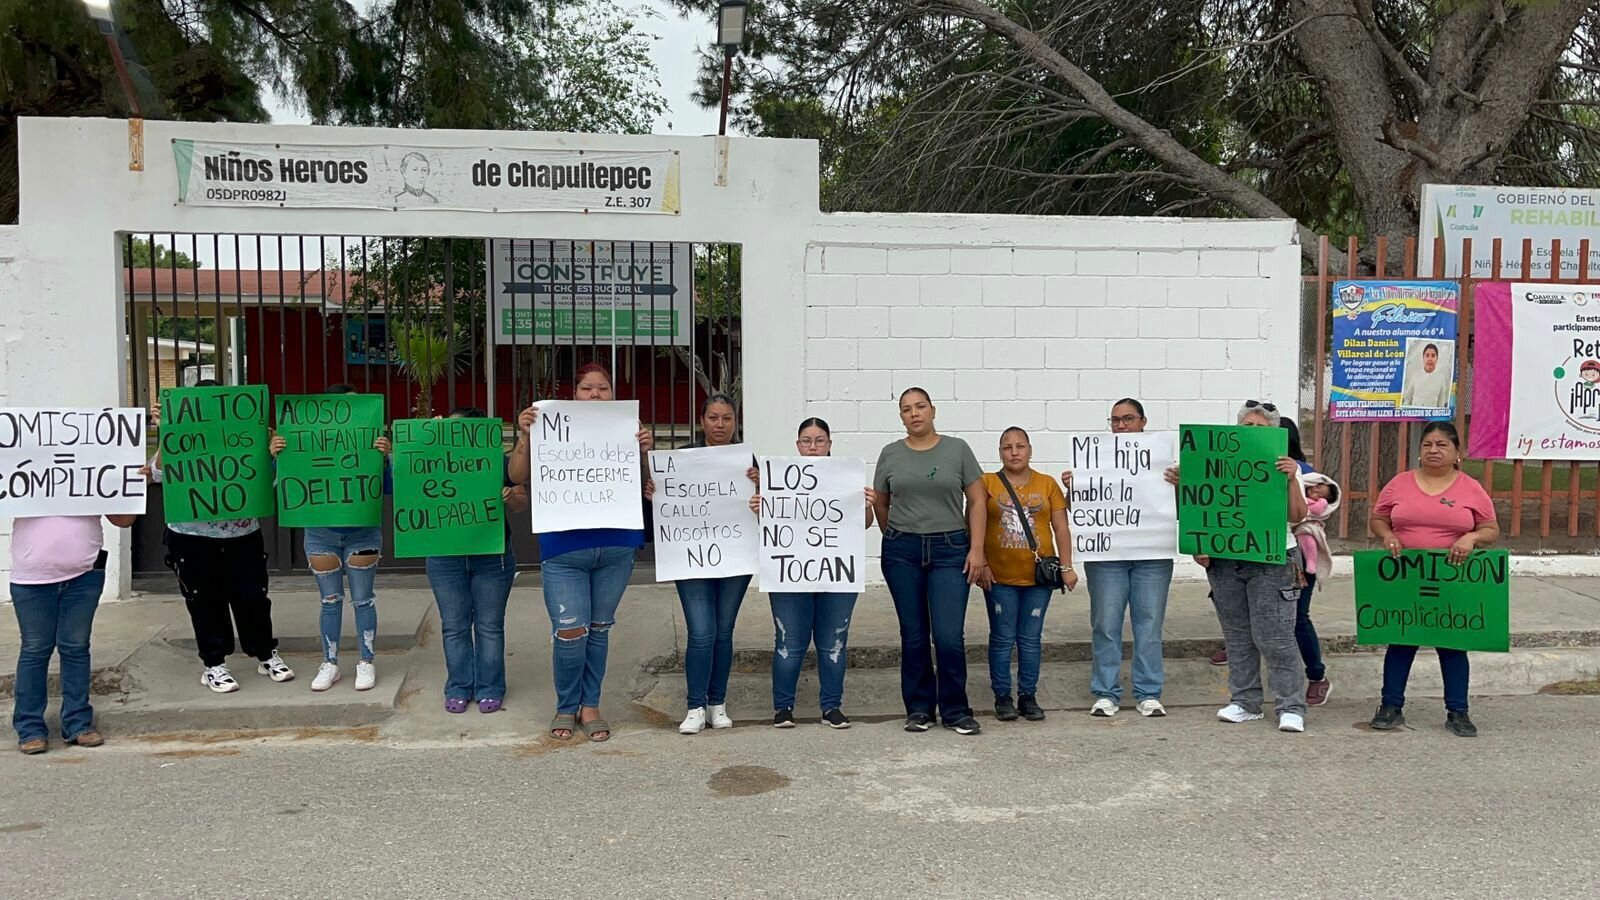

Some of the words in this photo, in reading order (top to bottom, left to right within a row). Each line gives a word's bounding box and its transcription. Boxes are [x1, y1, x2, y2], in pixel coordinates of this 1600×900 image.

[204, 150, 273, 182] Niños
[279, 158, 368, 184] Heroes
[472, 159, 501, 187] de
[508, 161, 651, 191] Chapultepec
[206, 188, 287, 201] 05DPR0982J
[605, 196, 627, 207] Z.E.
[629, 196, 651, 208] 307
[1497, 193, 1567, 205] GOBIERNO
[1571, 195, 1595, 206] DEL
[1450, 223, 1478, 231] Coahuila
[1510, 208, 1600, 226] REHABIL
[1537, 247, 1573, 257] Escela
[517, 264, 663, 281] CONSTRUYE
[1344, 339, 1366, 347] Dilan
[1367, 338, 1399, 347] Damián
[1354, 328, 1360, 336] A
[1392, 328, 1420, 336] alumno
[1422, 328, 1430, 336] de
[1337, 350, 1372, 358] Villareal
[1373, 350, 1384, 358] de
[1385, 349, 1404, 358] León
[280, 399, 351, 425] ACOSO
[395, 423, 417, 444] EL
[421, 421, 502, 448] SILENCIO
[542, 412, 571, 442] Mi
[537, 441, 596, 463] Escuela
[600, 442, 635, 464] debe
[1180, 430, 1196, 451] A
[1208, 430, 1241, 453] LOS
[401, 451, 491, 475] Tambien
[652, 455, 676, 473] LA
[1072, 436, 1099, 469] Mi
[1115, 435, 1151, 476] hija
[164, 452, 256, 485] NIÑOS
[766, 460, 818, 491] LOS
[1205, 455, 1270, 483] NIÑOS
[281, 474, 382, 511] DELITO
[422, 479, 457, 498] es
[538, 490, 557, 504] NO
[563, 489, 617, 504] CALLAR
[664, 477, 738, 498] ESCUELA
[1120, 478, 1133, 502] la
[1182, 483, 1214, 506] NO
[1219, 484, 1249, 508] SE
[188, 483, 246, 519] NO
[761, 493, 843, 523] NIÑOS
[395, 498, 499, 533] CULPABLE
[1073, 505, 1140, 527] escuela
[1202, 511, 1246, 529] LES
[763, 524, 794, 548] NO
[806, 526, 839, 548] SE
[687, 543, 721, 568] NO
[1378, 550, 1505, 584] OMISIÓN
[771, 555, 855, 583] TOCAN
